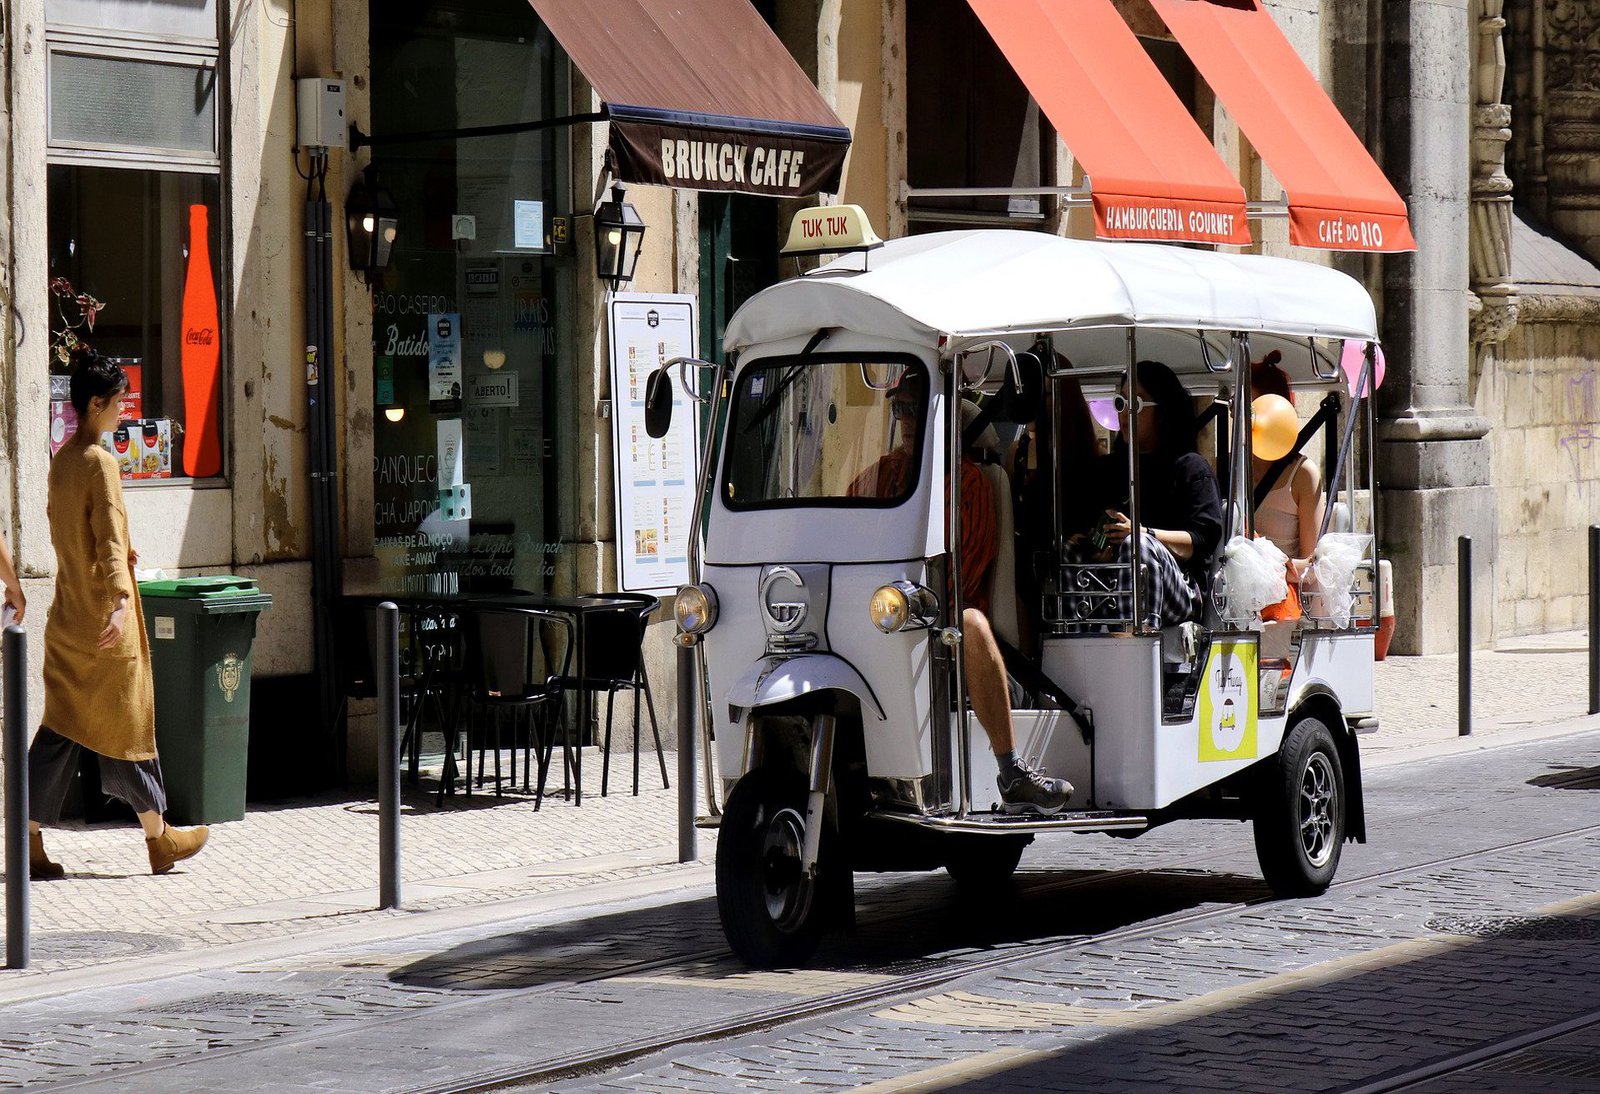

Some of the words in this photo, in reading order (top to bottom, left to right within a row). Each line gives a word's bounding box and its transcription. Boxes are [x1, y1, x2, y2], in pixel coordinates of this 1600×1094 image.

[661, 138, 748, 184] BRUNCH
[751, 147, 804, 188] CAFE
[802, 218, 823, 238] TUK
[827, 216, 848, 236] TUK
[1106, 207, 1184, 232] HAMBURGUERIA
[1189, 211, 1234, 236] GOURMET
[1319, 217, 1343, 243] CAFÉ
[1361, 221, 1383, 247] RIO
[399, 295, 446, 314] CASEIRO
[475, 378, 510, 399] ABERTO!
[374, 497, 397, 525] CHÁ
[405, 535, 416, 548] DE
